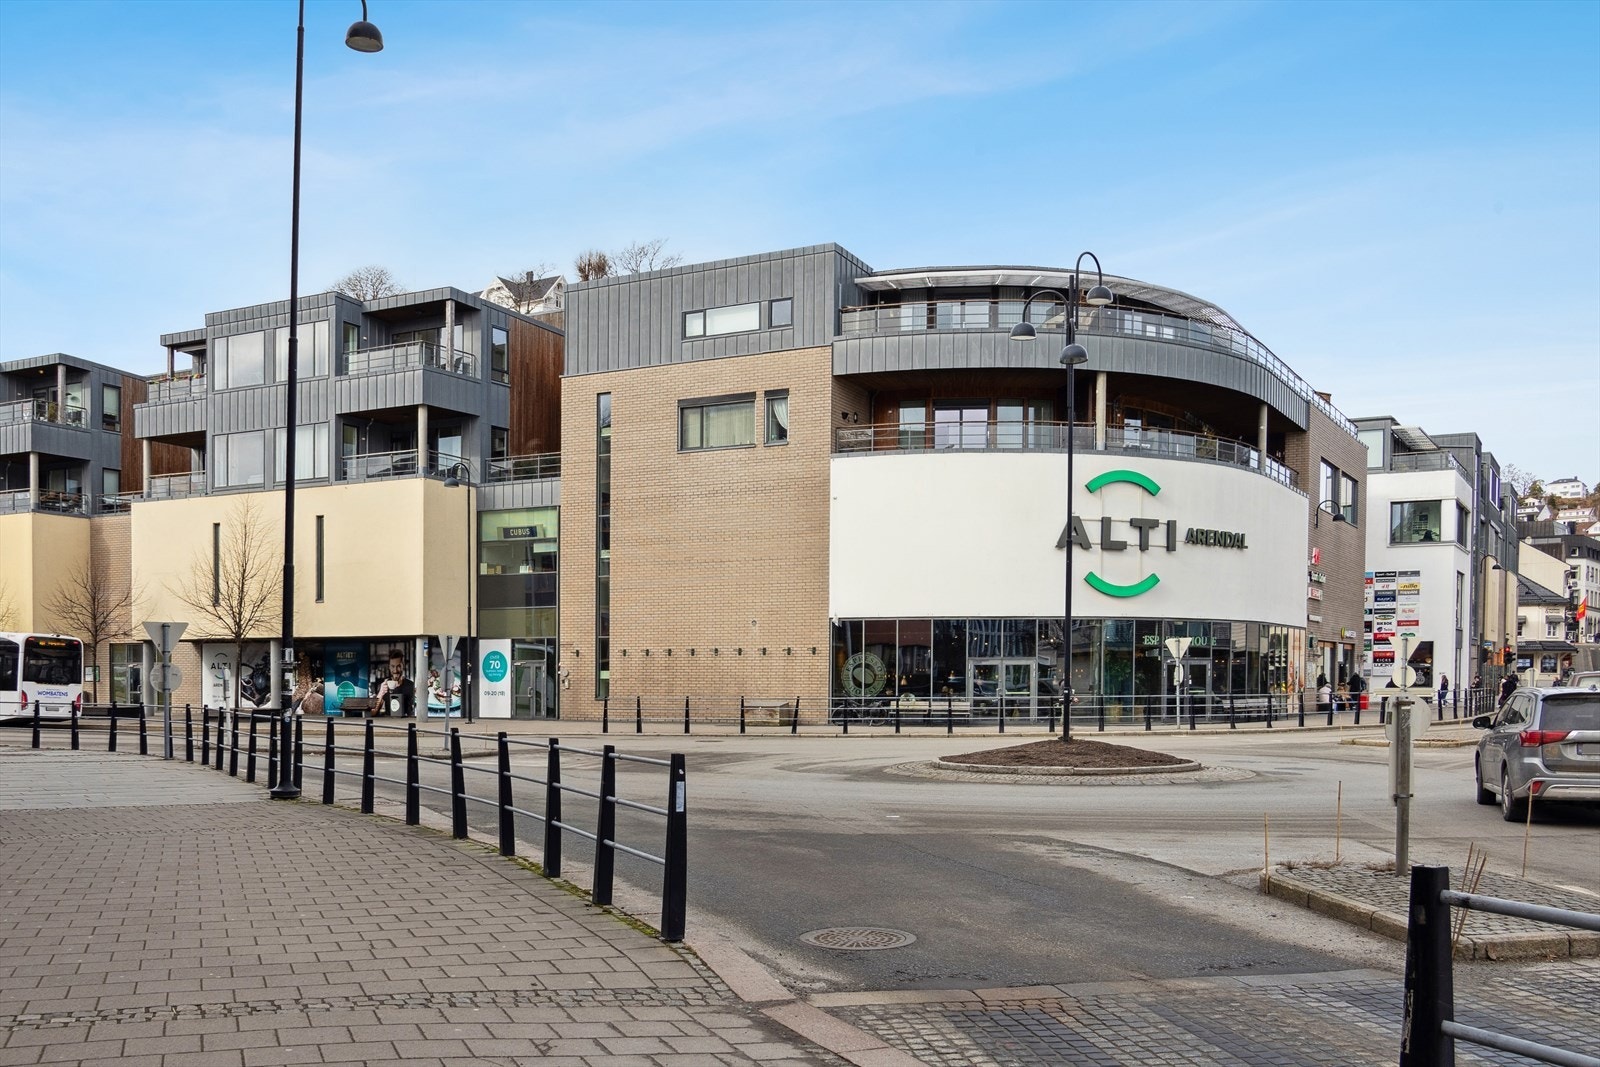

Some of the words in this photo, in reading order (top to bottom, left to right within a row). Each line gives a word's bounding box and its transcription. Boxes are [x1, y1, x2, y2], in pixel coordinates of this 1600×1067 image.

[509, 528, 530, 536] CUBUS
[1055, 515, 1177, 552] ALTI
[1185, 527, 1249, 550] ARENDAL
[210, 662, 232, 670] ALTI
[489, 660, 501, 669] 70
